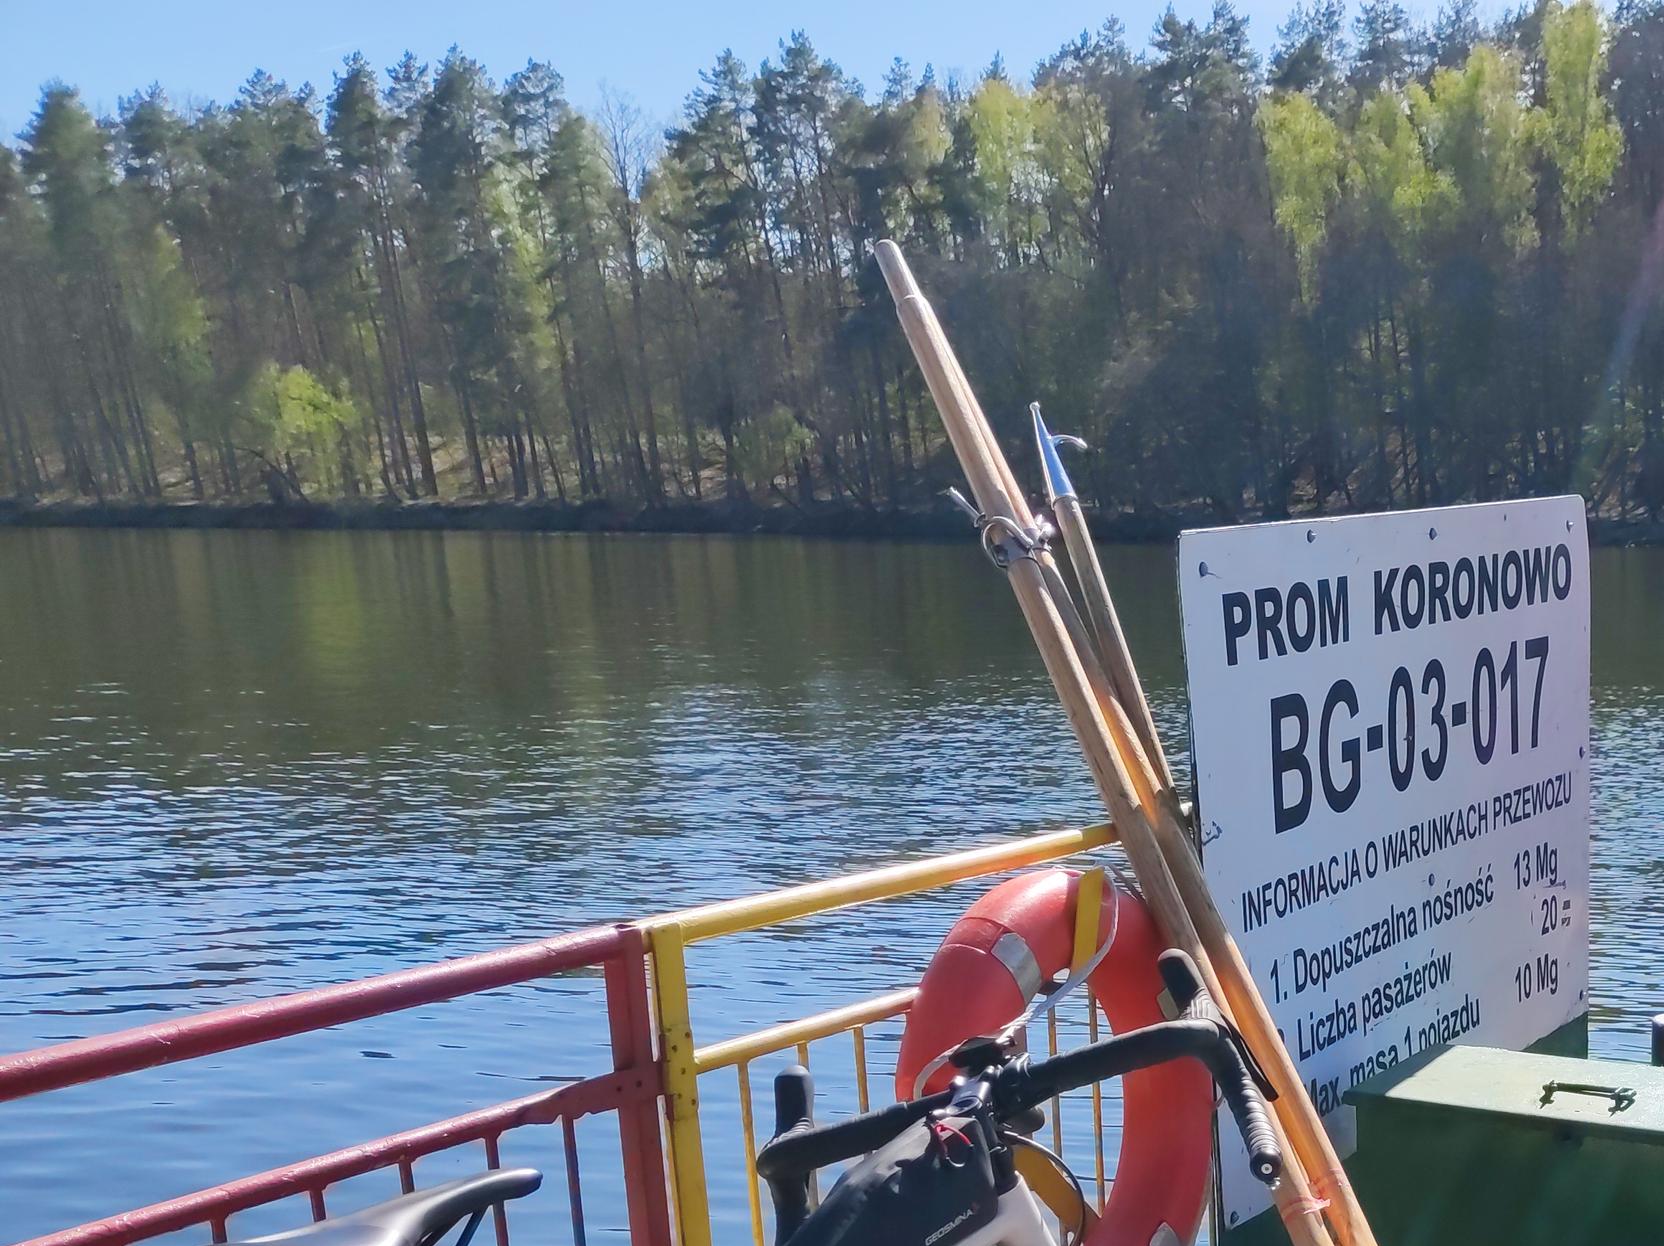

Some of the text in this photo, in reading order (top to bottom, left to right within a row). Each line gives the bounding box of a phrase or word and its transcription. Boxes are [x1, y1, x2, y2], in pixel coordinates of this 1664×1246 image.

[1222, 544, 1572, 666] PROM KORONOWO
[1270, 636, 1549, 835] BG-03-017
[1241, 772, 1572, 933] INFORMACJA O WARUNKACH PRZEWOZU
[1270, 842, 1558, 1004] 1. Dopuszczalna nośność 13 Mg
[1297, 1000, 1357, 1062] Liczba
[1362, 949, 1452, 1036] pasażerów
[1541, 895, 1558, 936] 20
[1350, 1044, 1399, 1088] masa
[1404, 1025, 1413, 1057] 1
[1418, 994, 1480, 1052] pojazdu
[1515, 962, 1532, 1003] 10
[1537, 953, 1559, 995] Mg
